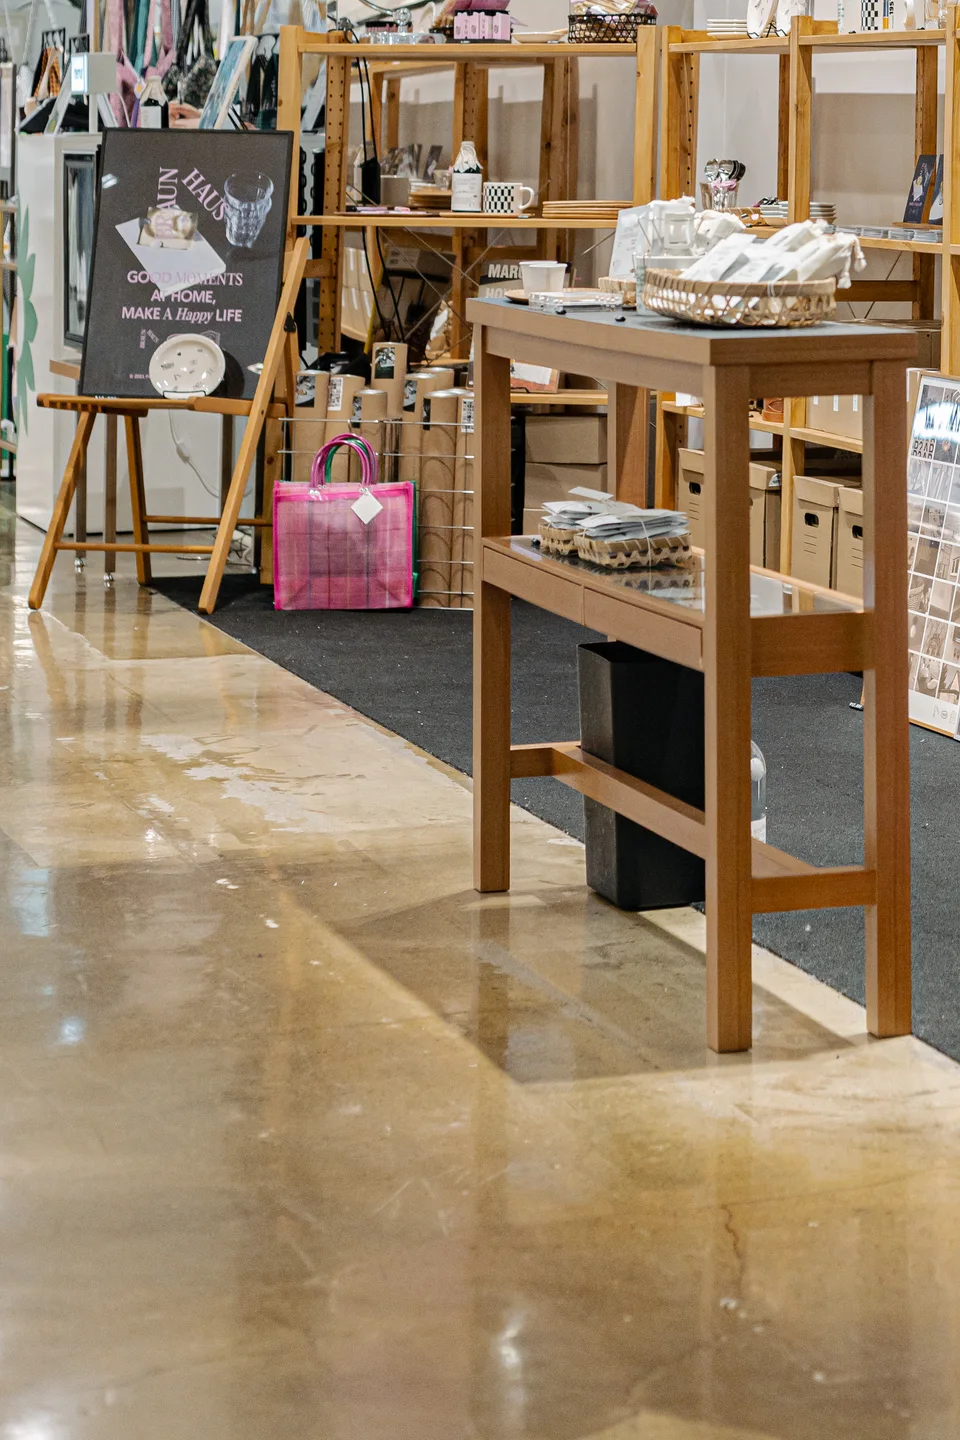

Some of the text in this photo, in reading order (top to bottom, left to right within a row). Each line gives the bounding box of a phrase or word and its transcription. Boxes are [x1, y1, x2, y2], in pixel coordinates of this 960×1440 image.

[154, 166, 231, 239] BRAUN HAUS
[127, 270, 243, 286] GOOD MOMENTS
[488, 263, 523, 279] MAR
[150, 289, 216, 306] AT HOME,
[485, 287, 507, 298] HO
[121, 307, 242, 324] MAKE A Happy LIFE
